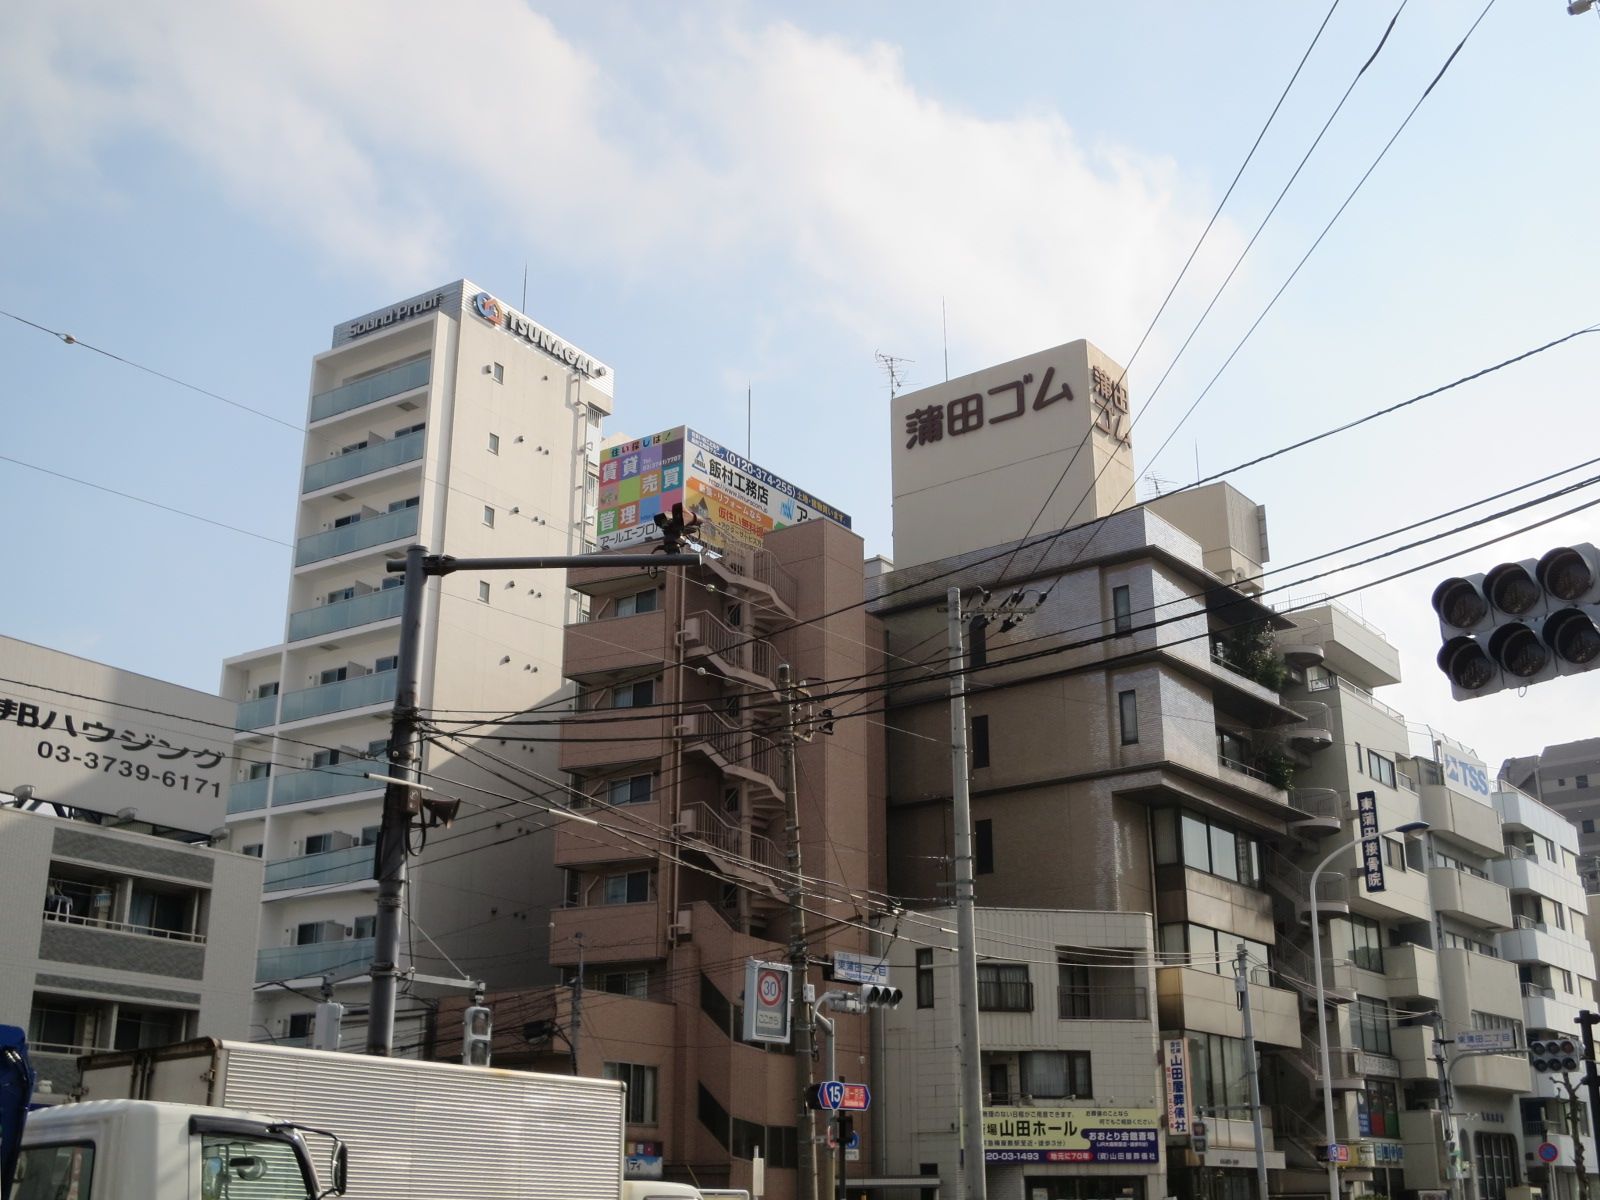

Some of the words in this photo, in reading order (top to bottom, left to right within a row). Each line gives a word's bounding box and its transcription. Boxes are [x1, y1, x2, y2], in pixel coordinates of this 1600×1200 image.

[349, 310, 393, 338] Sound
[399, 293, 443, 323] Proof
[905, 366, 1074, 450] 蒲田ゴム
[602, 455, 639, 483] 賃貸
[642, 466, 681, 494] 売買
[709, 459, 769, 506] 飯村工務店
[600, 505, 637, 532] 管理
[37, 741, 221, 799] 03-3739-6171
[1458, 760, 1489, 797] TSS
[1359, 797, 1382, 888] 東蒲田接骨院
[763, 981, 777, 996] 30
[829, 1086, 841, 1103] 15
